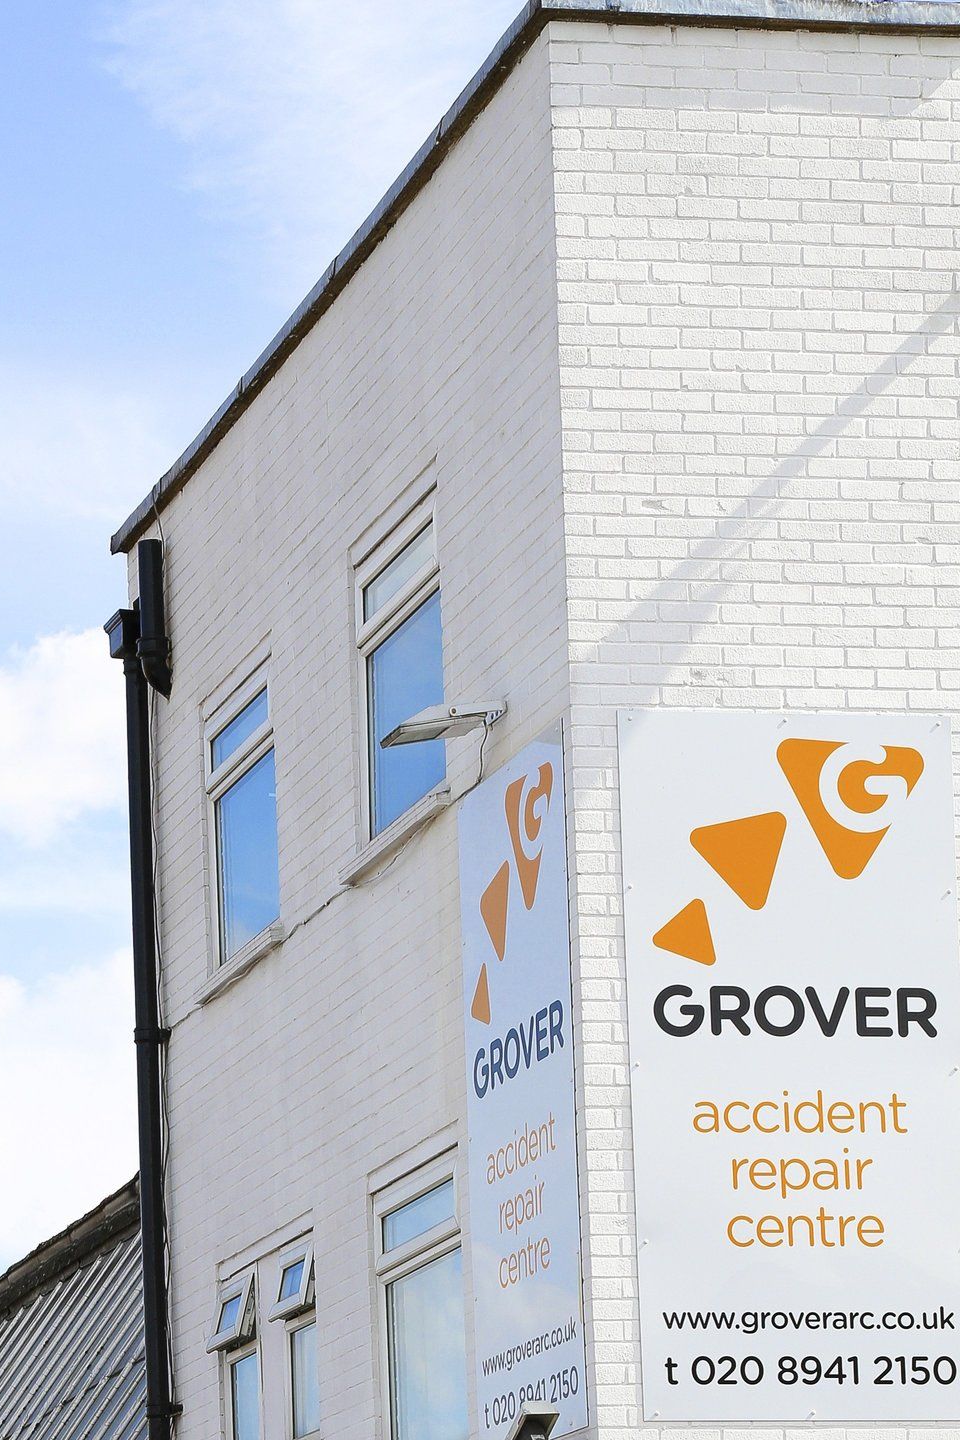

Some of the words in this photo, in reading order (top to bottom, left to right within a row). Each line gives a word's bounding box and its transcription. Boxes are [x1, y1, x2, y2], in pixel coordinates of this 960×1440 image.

[653, 984, 938, 1038] GROVER
[473, 999, 565, 1099] GROVER
[692, 1089, 908, 1133] accident
[486, 1111, 556, 1184] accident
[731, 1147, 873, 1199] repair
[498, 1174, 545, 1235] repair
[726, 1206, 885, 1248] centre
[498, 1236, 551, 1289] centre
[662, 1306, 955, 1334] www.groverarc.co.uk
[482, 1318, 577, 1377] www.groverarc.co.uk
[664, 1357, 679, 1385] t
[691, 1355, 764, 1386] 020
[777, 1355, 860, 1386] 8941
[873, 1355, 957, 1386] 2150
[484, 1403, 491, 1429] t
[492, 1391, 516, 1426] 020
[549, 1365, 579, 1404] 2150
